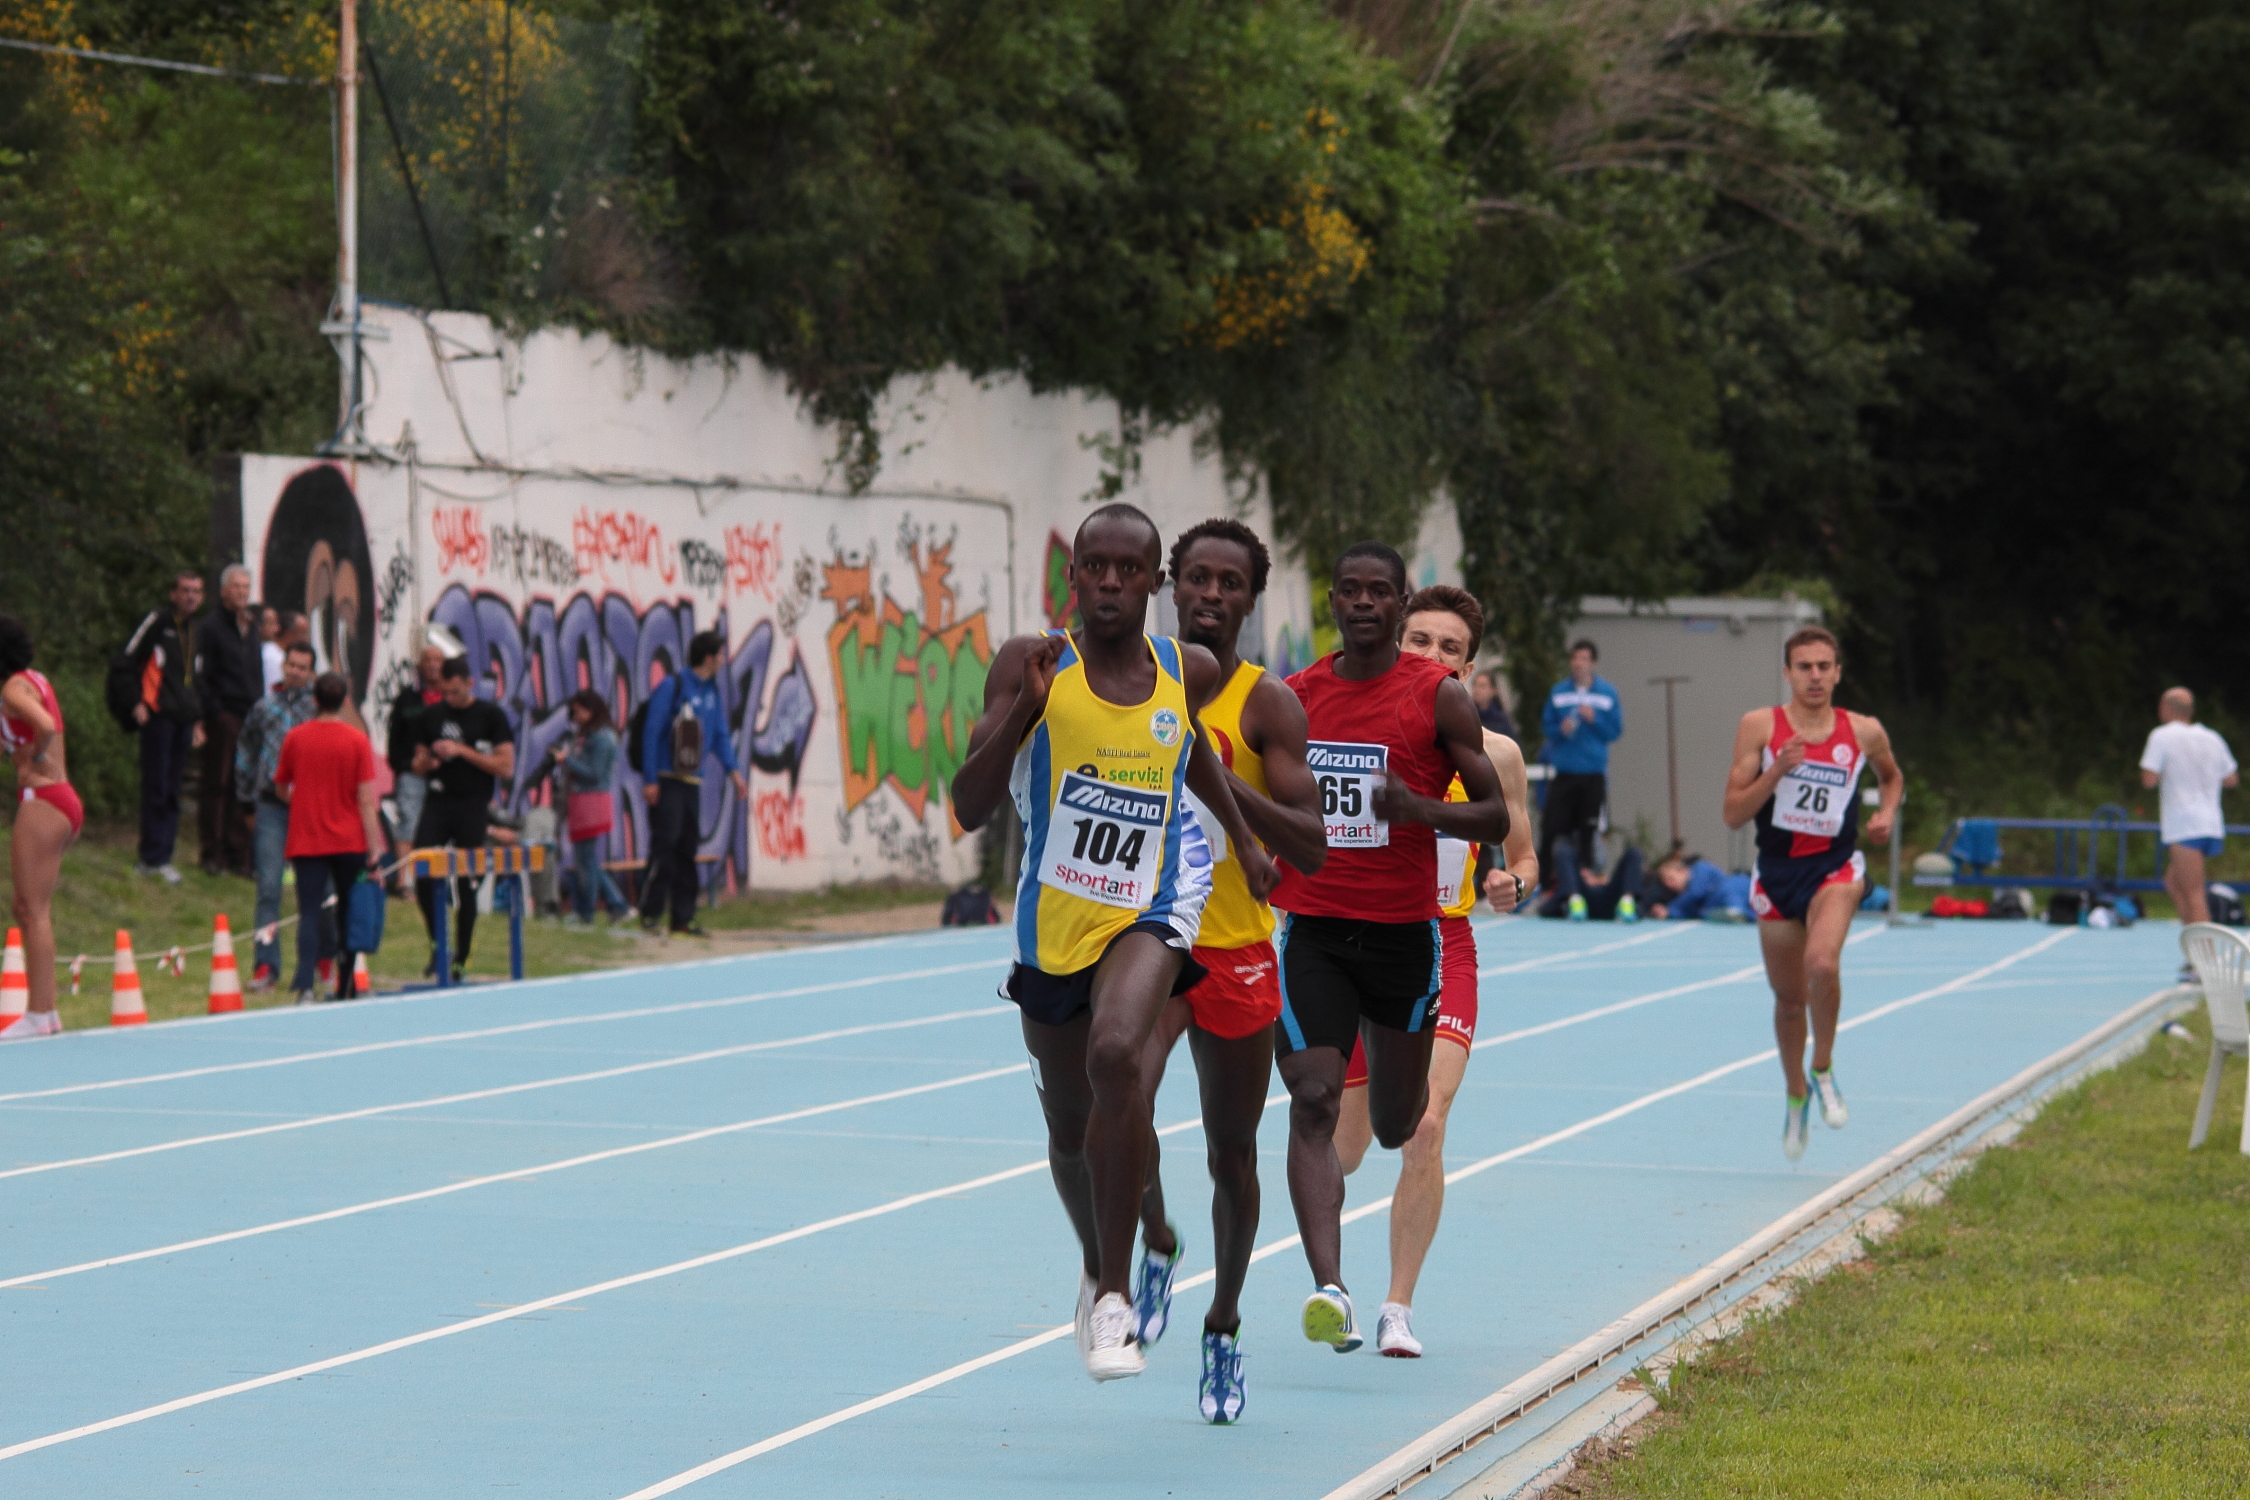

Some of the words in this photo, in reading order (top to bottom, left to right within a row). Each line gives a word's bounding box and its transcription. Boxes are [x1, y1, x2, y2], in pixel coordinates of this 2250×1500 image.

[1318, 775, 1362, 818] 65
[1795, 784, 1830, 813] 26
[1072, 818, 1146, 872] 104
[1324, 823, 1373, 837] ortart
[1055, 863, 1136, 897] sportart
[1436, 1014, 1472, 1040] FILA
